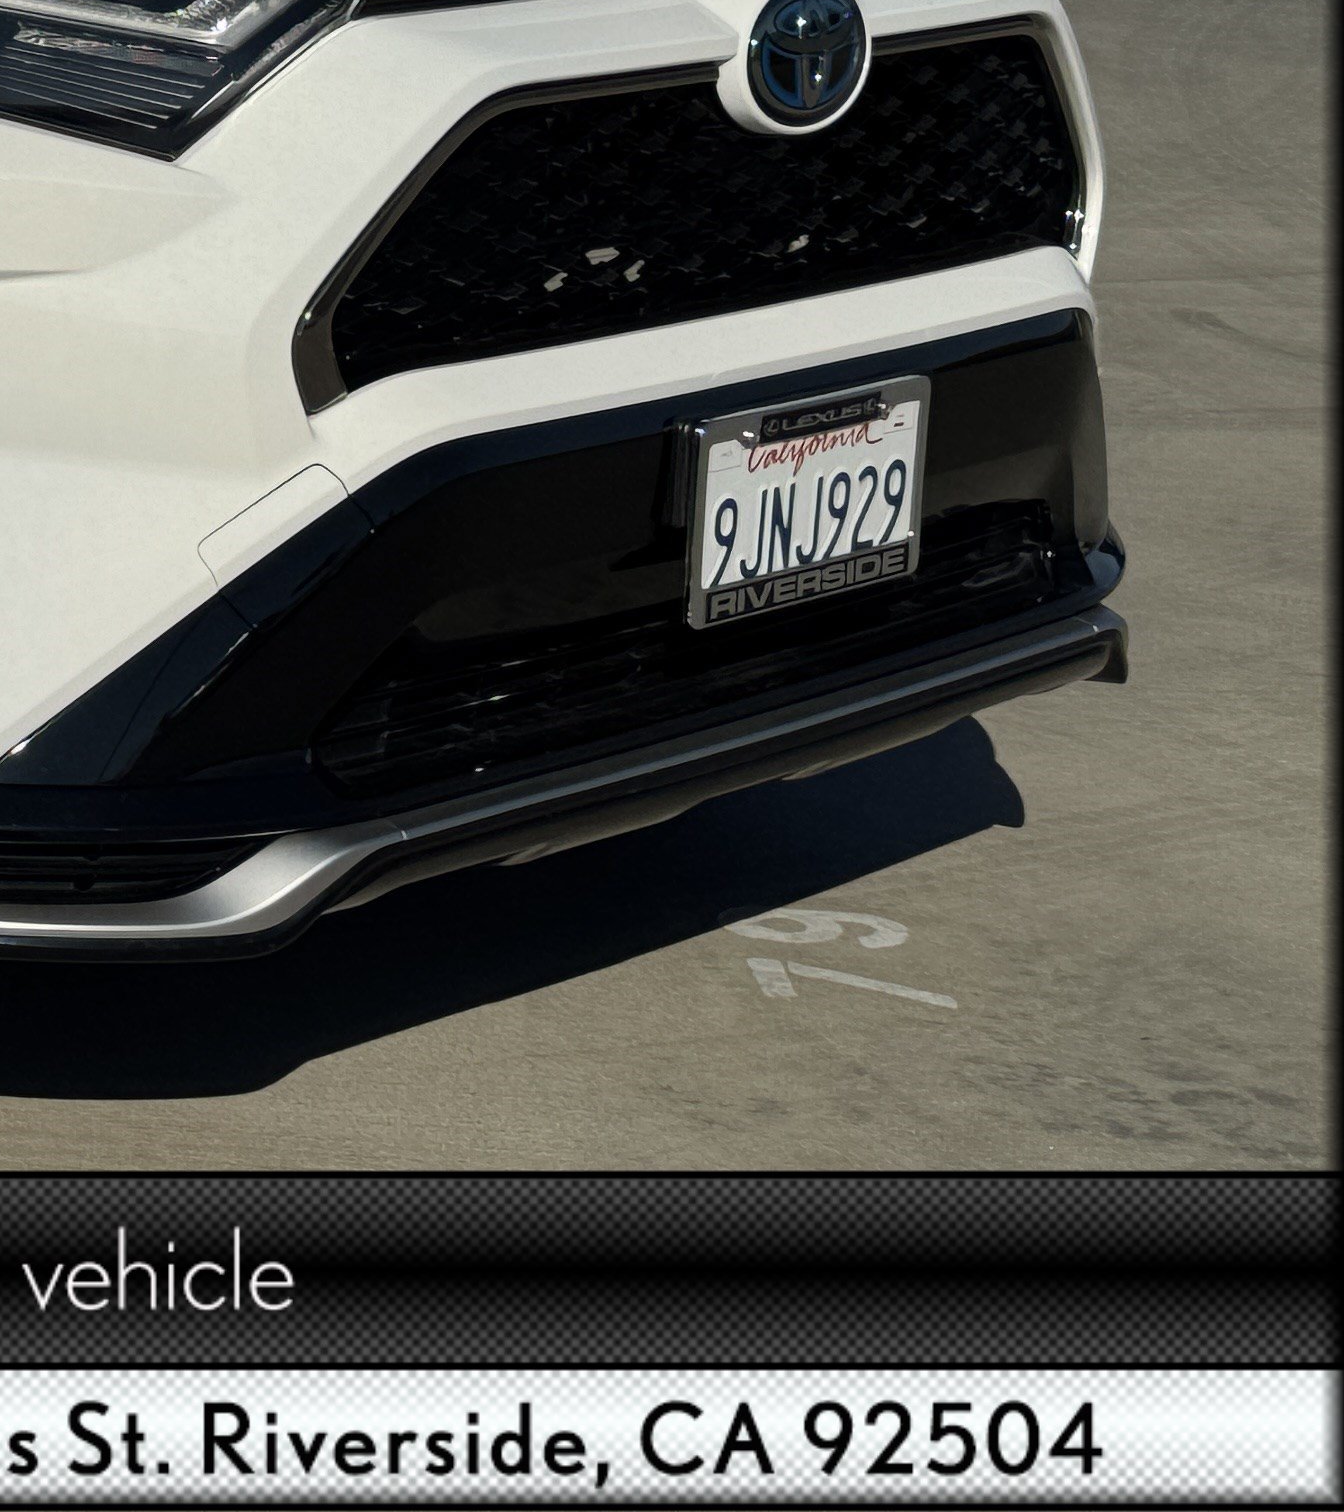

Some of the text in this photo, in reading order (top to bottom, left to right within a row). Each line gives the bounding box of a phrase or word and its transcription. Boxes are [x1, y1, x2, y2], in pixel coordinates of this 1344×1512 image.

[748, 421, 884, 477] California
[782, 403, 862, 431] LEXUS
[710, 458, 908, 589] 9JNJ929
[710, 546, 907, 621] RIVERSIDE
